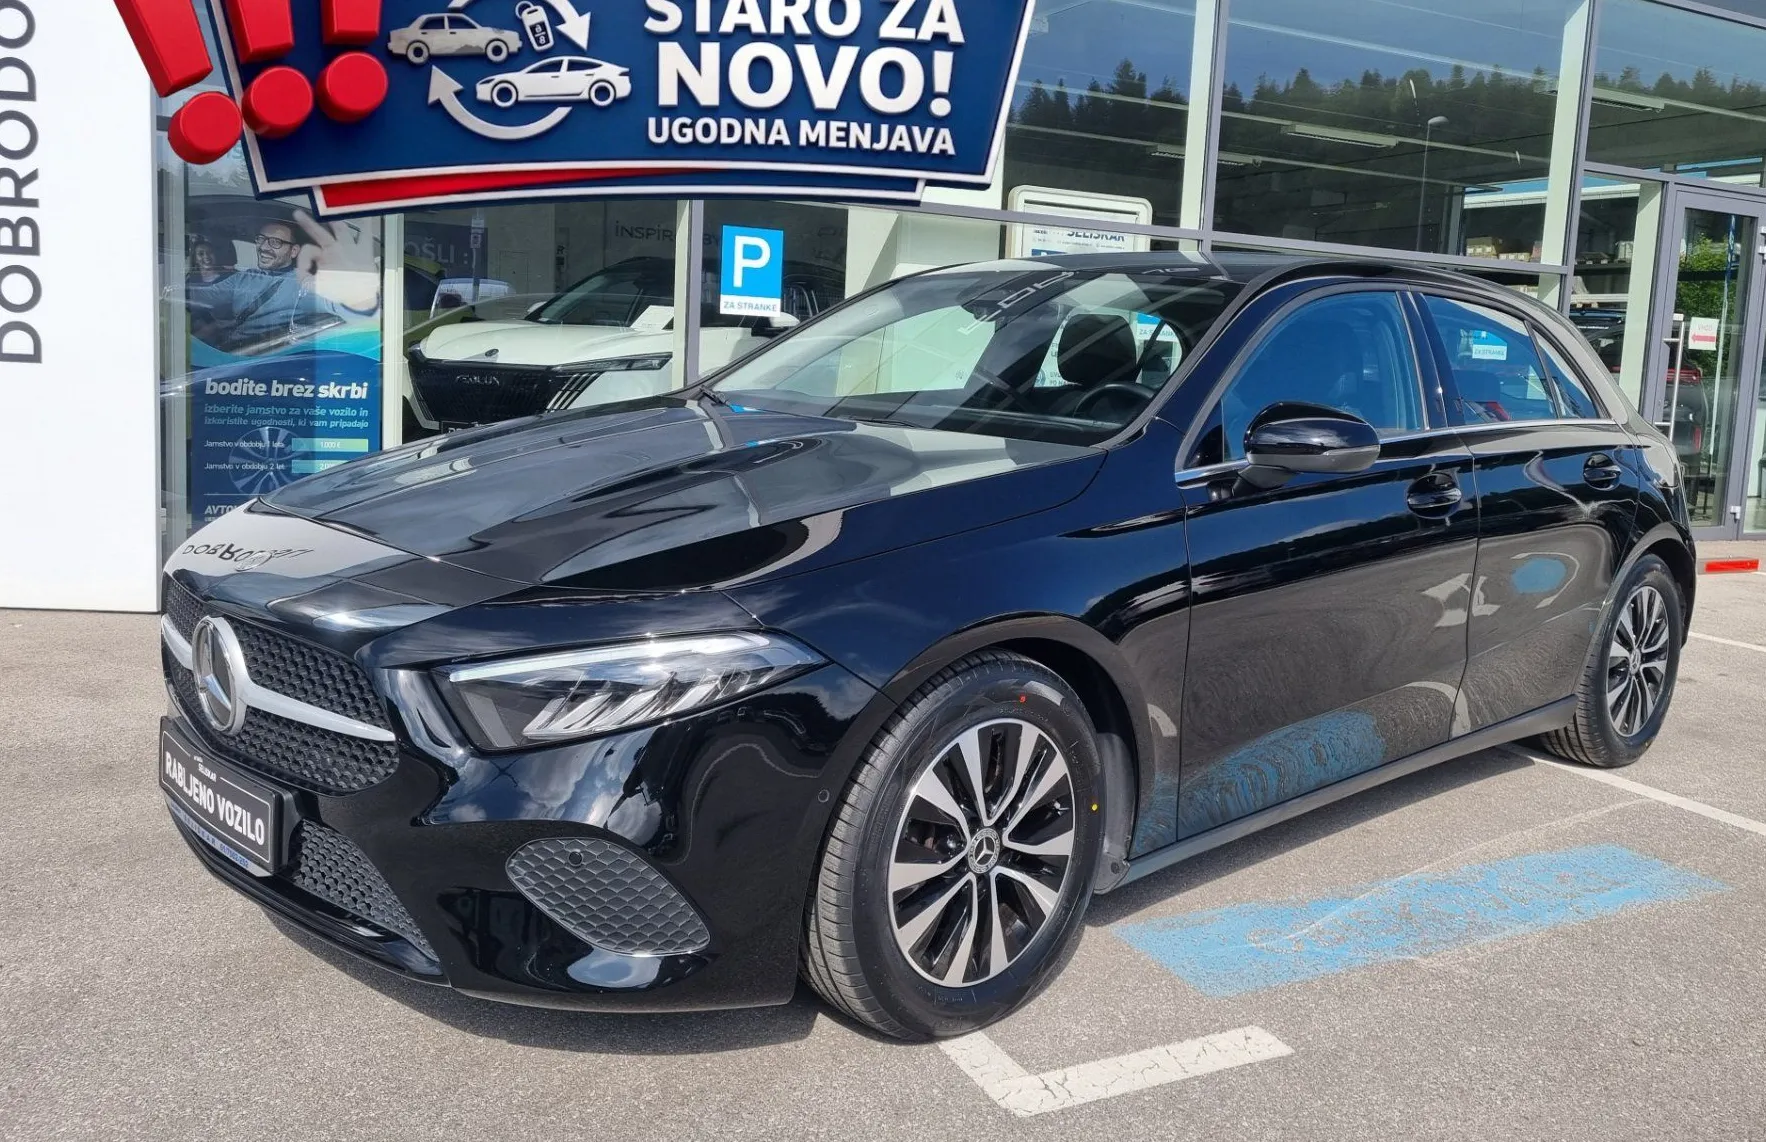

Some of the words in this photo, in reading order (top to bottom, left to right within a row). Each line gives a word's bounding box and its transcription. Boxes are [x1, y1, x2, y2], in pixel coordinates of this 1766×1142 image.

[733, 235, 771, 288] P
[723, 301, 736, 310] ZA
[737, 302, 778, 312] STRANKE
[205, 378, 267, 396] bodite
[270, 380, 315, 398] brez
[317, 382, 369, 399] skrbi
[204, 404, 244, 414] izberite
[245, 404, 287, 416] jamstvo
[288, 407, 300, 415] za
[303, 405, 327, 416] vaše
[329, 407, 357, 416] vozilo
[360, 407, 369, 417] in
[204, 416, 248, 425] izkoristite
[329, 419, 369, 429] pripadajo
[204, 440, 234, 449] Jamstvo
[241, 463, 268, 472] obdobju
[165, 751, 215, 815] RABLJENO
[216, 793, 265, 846] VOZILO
